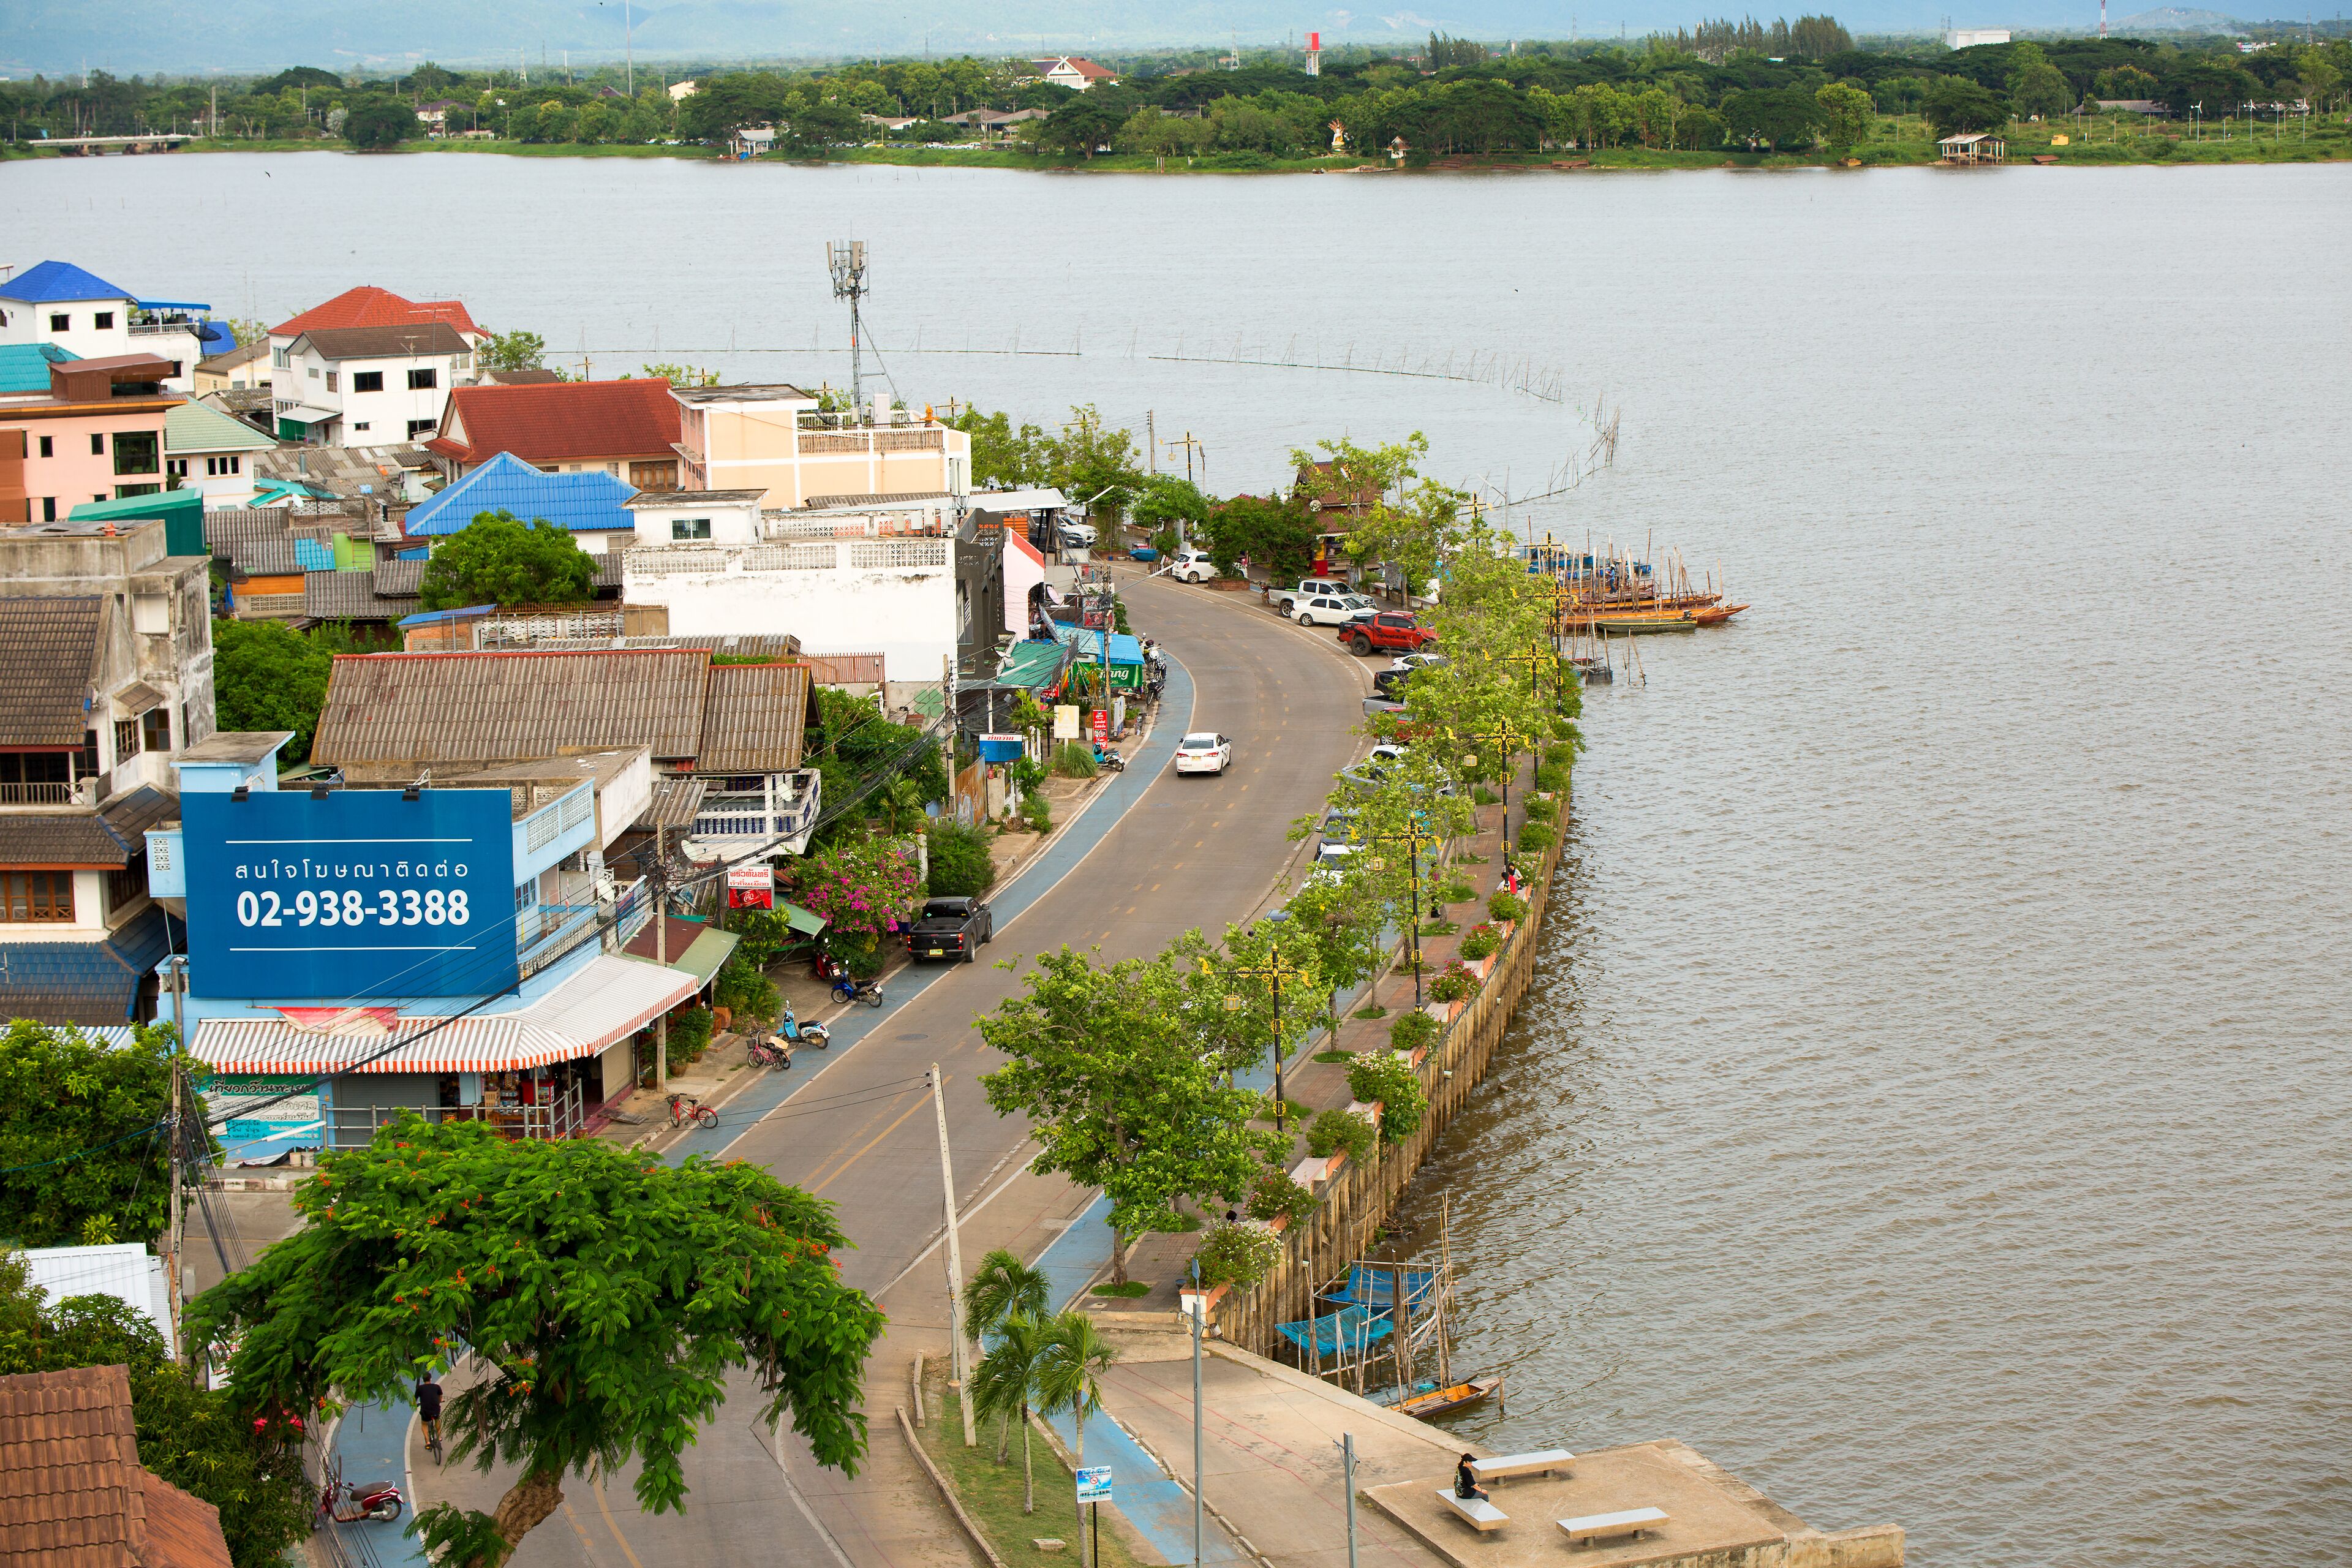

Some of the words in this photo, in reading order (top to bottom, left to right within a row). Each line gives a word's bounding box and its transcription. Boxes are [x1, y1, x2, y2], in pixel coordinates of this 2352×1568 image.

[235, 859, 468, 878] สนใจโฆษณาติดต่อ
[237, 889, 470, 927] 02-938-3388
